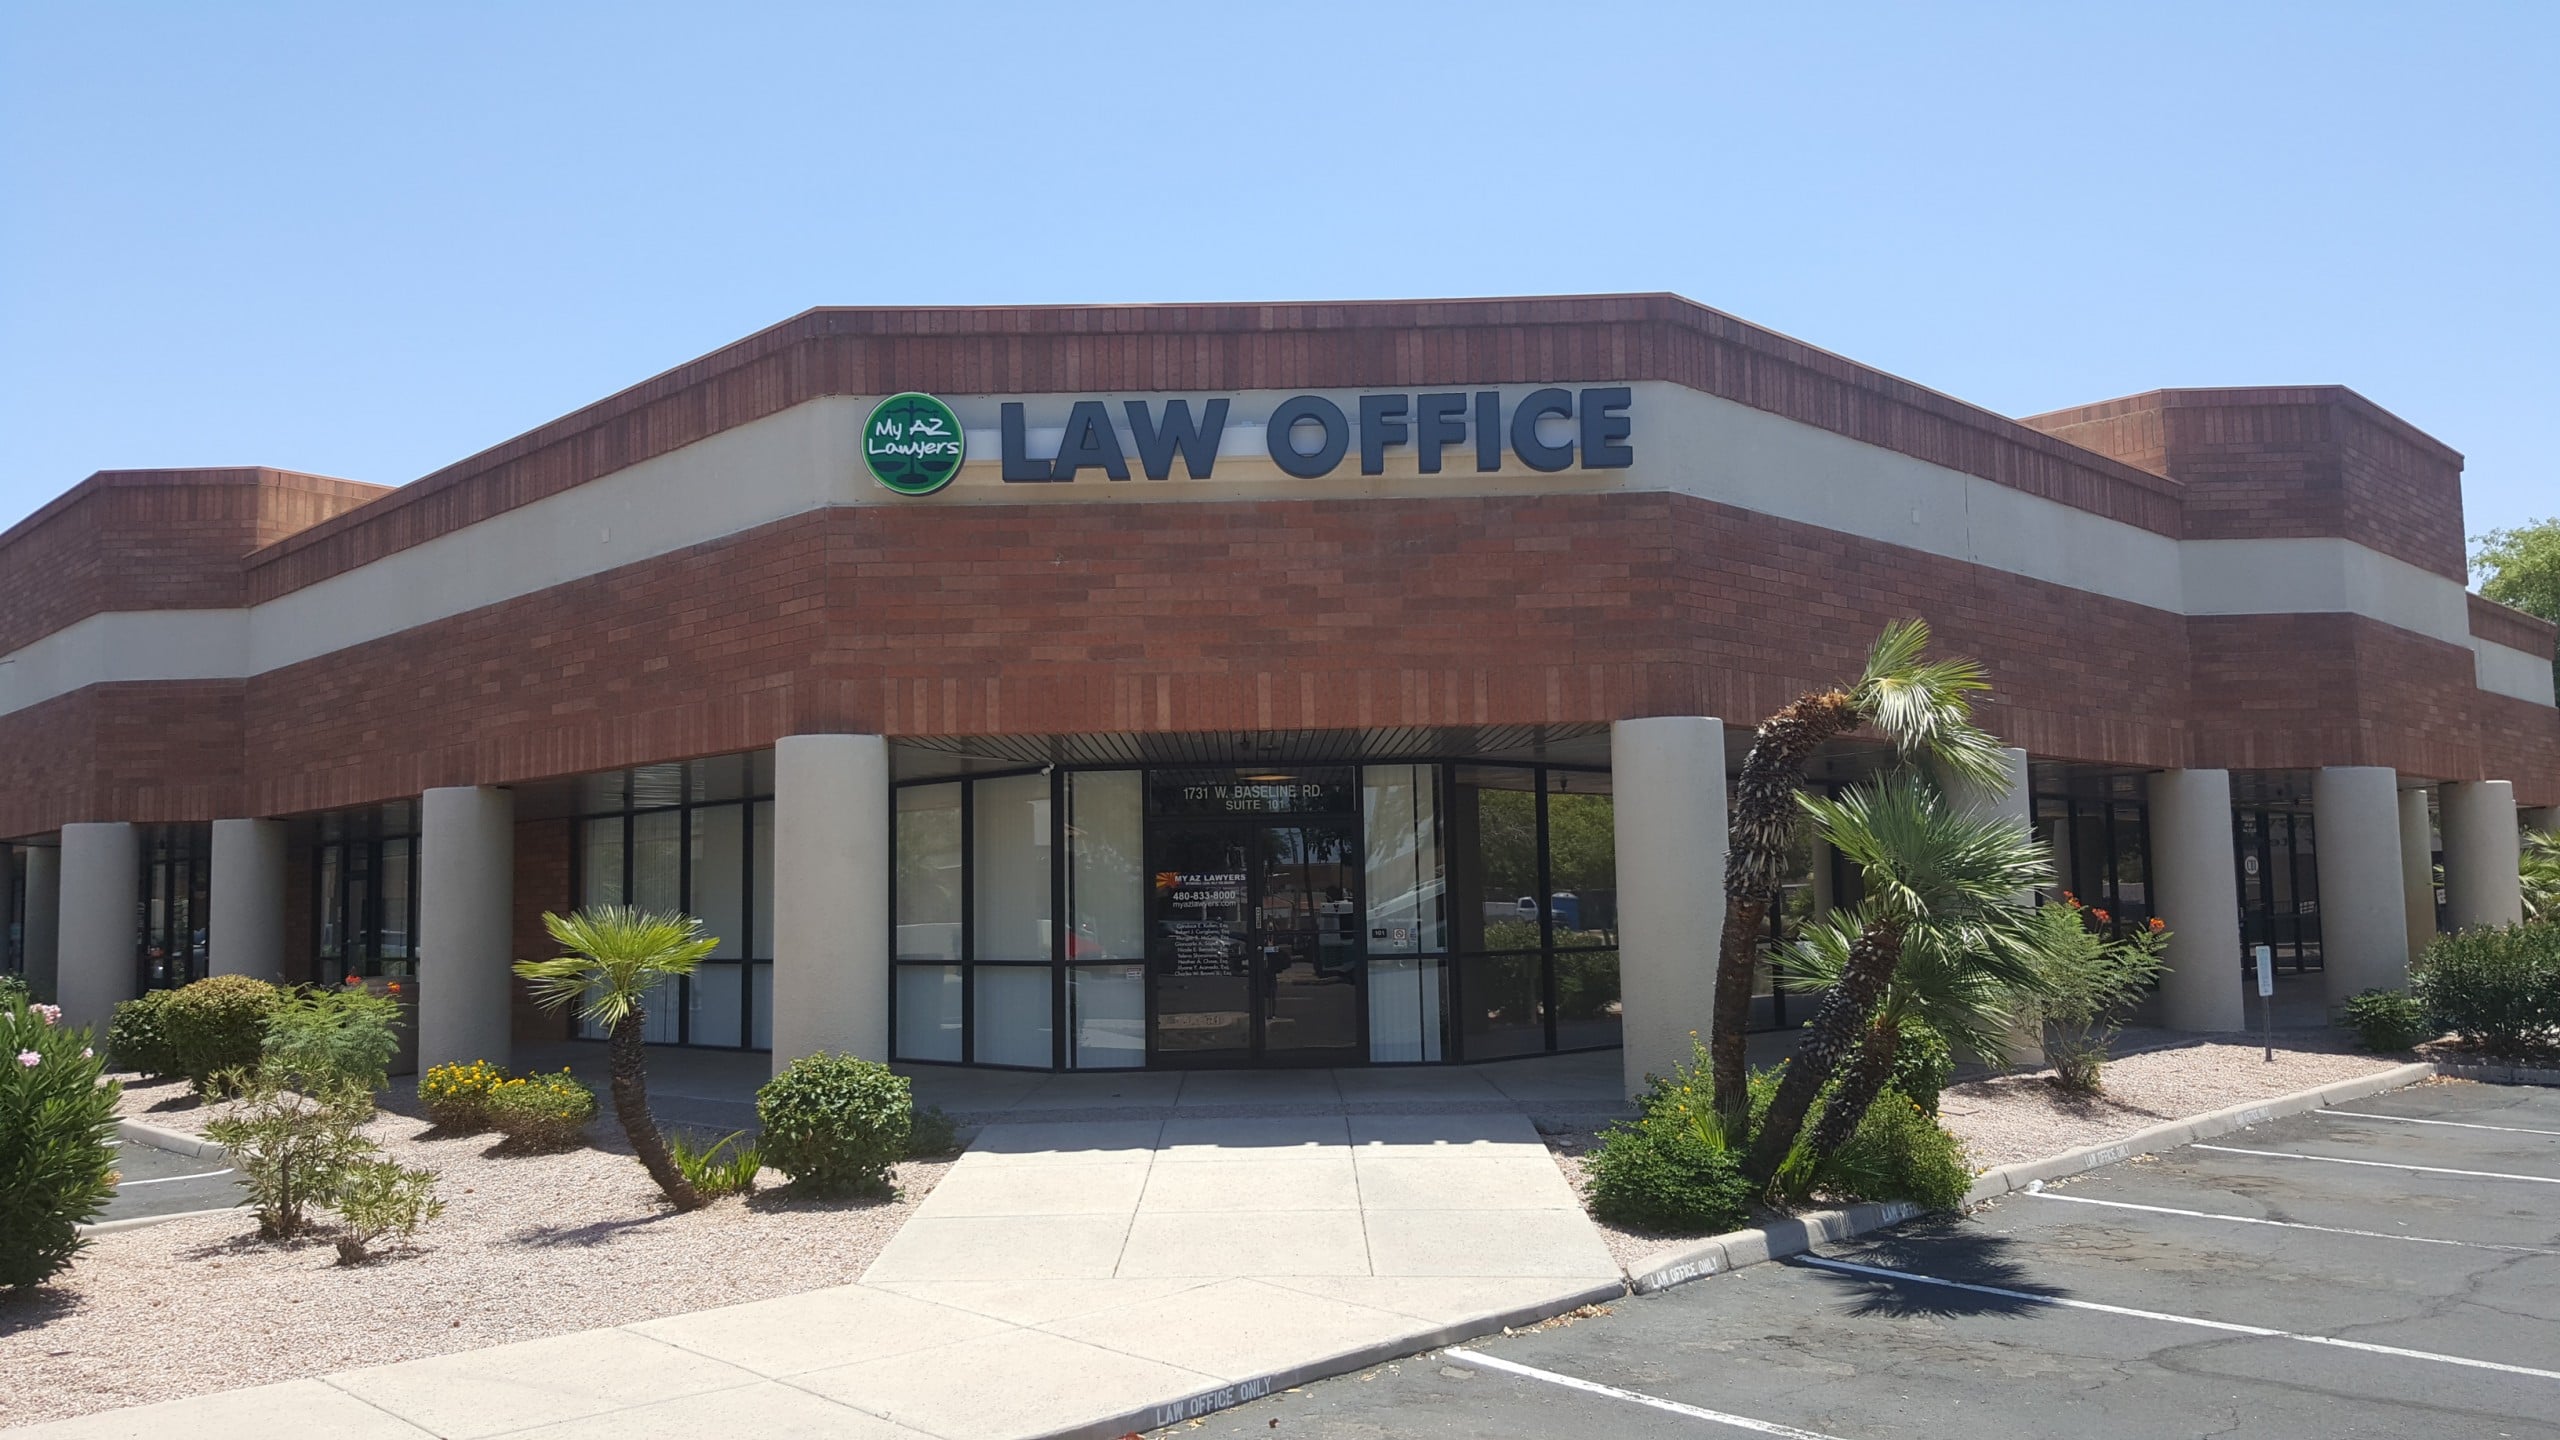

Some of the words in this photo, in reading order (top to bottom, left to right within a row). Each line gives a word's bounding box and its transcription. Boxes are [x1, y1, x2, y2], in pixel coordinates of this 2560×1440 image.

[876, 418, 902, 440] My
[909, 418, 952, 436] AZ
[1001, 398, 1230, 482] LAW
[1266, 387, 1633, 479] OFFICE
[868, 438, 960, 459] Lawyers
[1183, 787, 1208, 800] 1731
[1214, 786, 1229, 799] W.
[1234, 785, 1297, 799] BASELINE
[1302, 784, 1324, 797] RD.
[1226, 799, 1261, 810] SUITE
[1268, 800, 1284, 810] 101
[1172, 891, 1236, 901] 480-833-8000
[1172, 900, 1237, 909] myazlawyers.com
[1650, 1270, 1670, 1289] LAW
[1669, 1262, 1698, 1281] OFFICE
[1698, 1255, 1718, 1273] ONLY
[1156, 1401, 1184, 1427] LAW
[1190, 1387, 1235, 1416] OFFICE
[1240, 1376, 1271, 1401] ONLY
